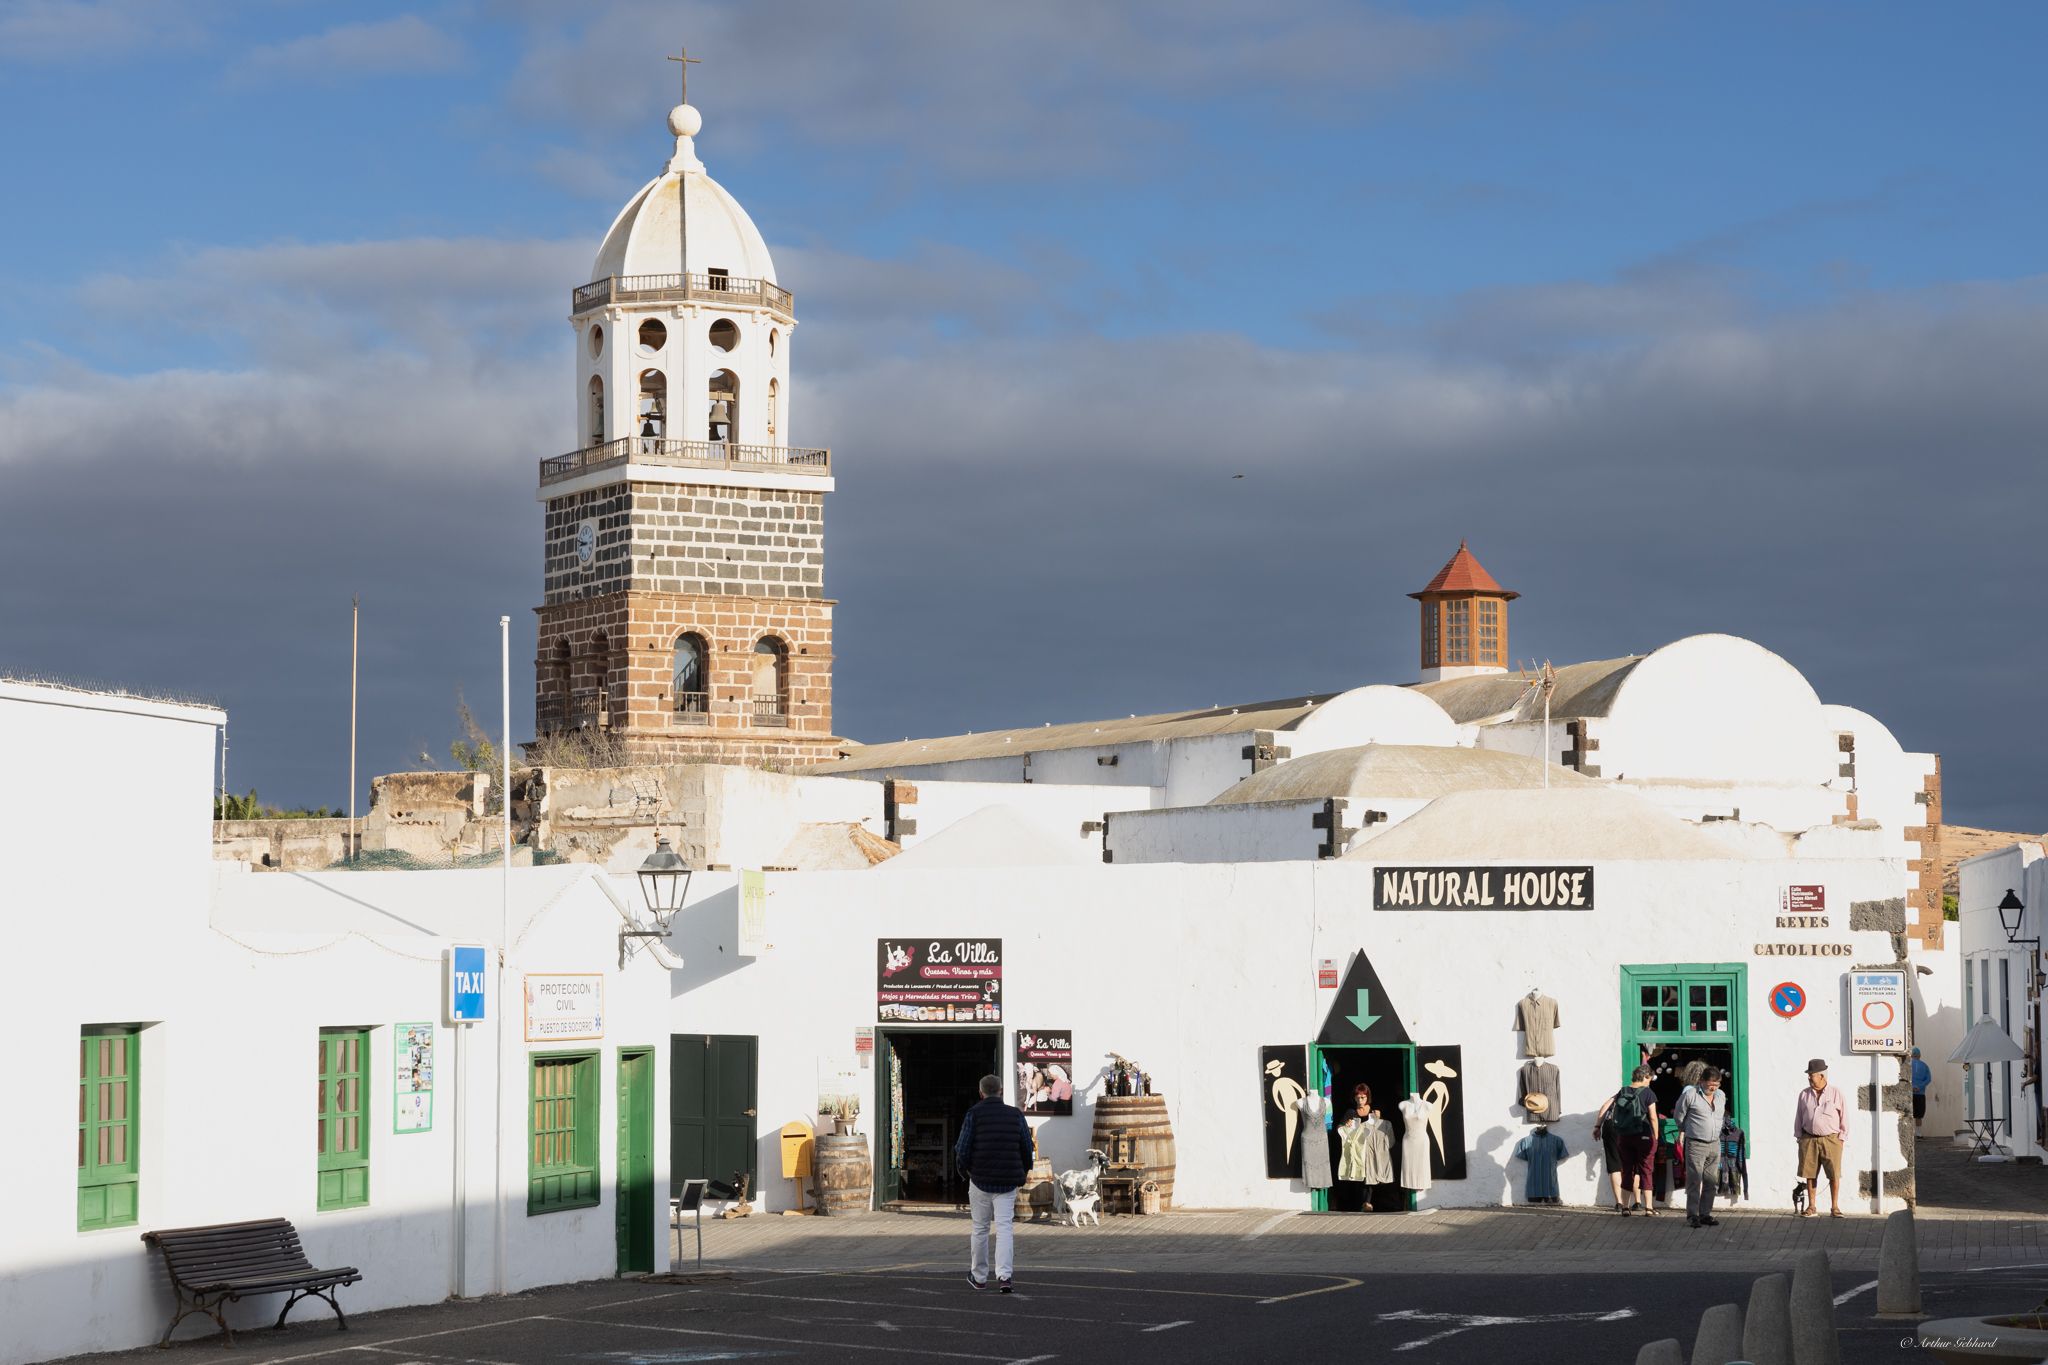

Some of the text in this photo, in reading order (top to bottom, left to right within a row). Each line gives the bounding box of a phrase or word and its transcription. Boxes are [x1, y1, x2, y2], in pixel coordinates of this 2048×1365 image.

[1382, 870, 1587, 907] NATURAL HOUSE
[1776, 916, 1830, 928] REYES
[927, 942, 999, 963] La Villa
[1753, 944, 1853, 957] CATOLICOS
[952, 967, 972, 976] Vinos
[972, 970, 978, 978] y
[456, 972, 484, 994] TAXI
[556, 1000, 576, 1010] CIVIL
[540, 1022, 560, 1034] PUESTO
[560, 1022, 568, 1032] DE
[1036, 1038, 1071, 1049] La Villa
